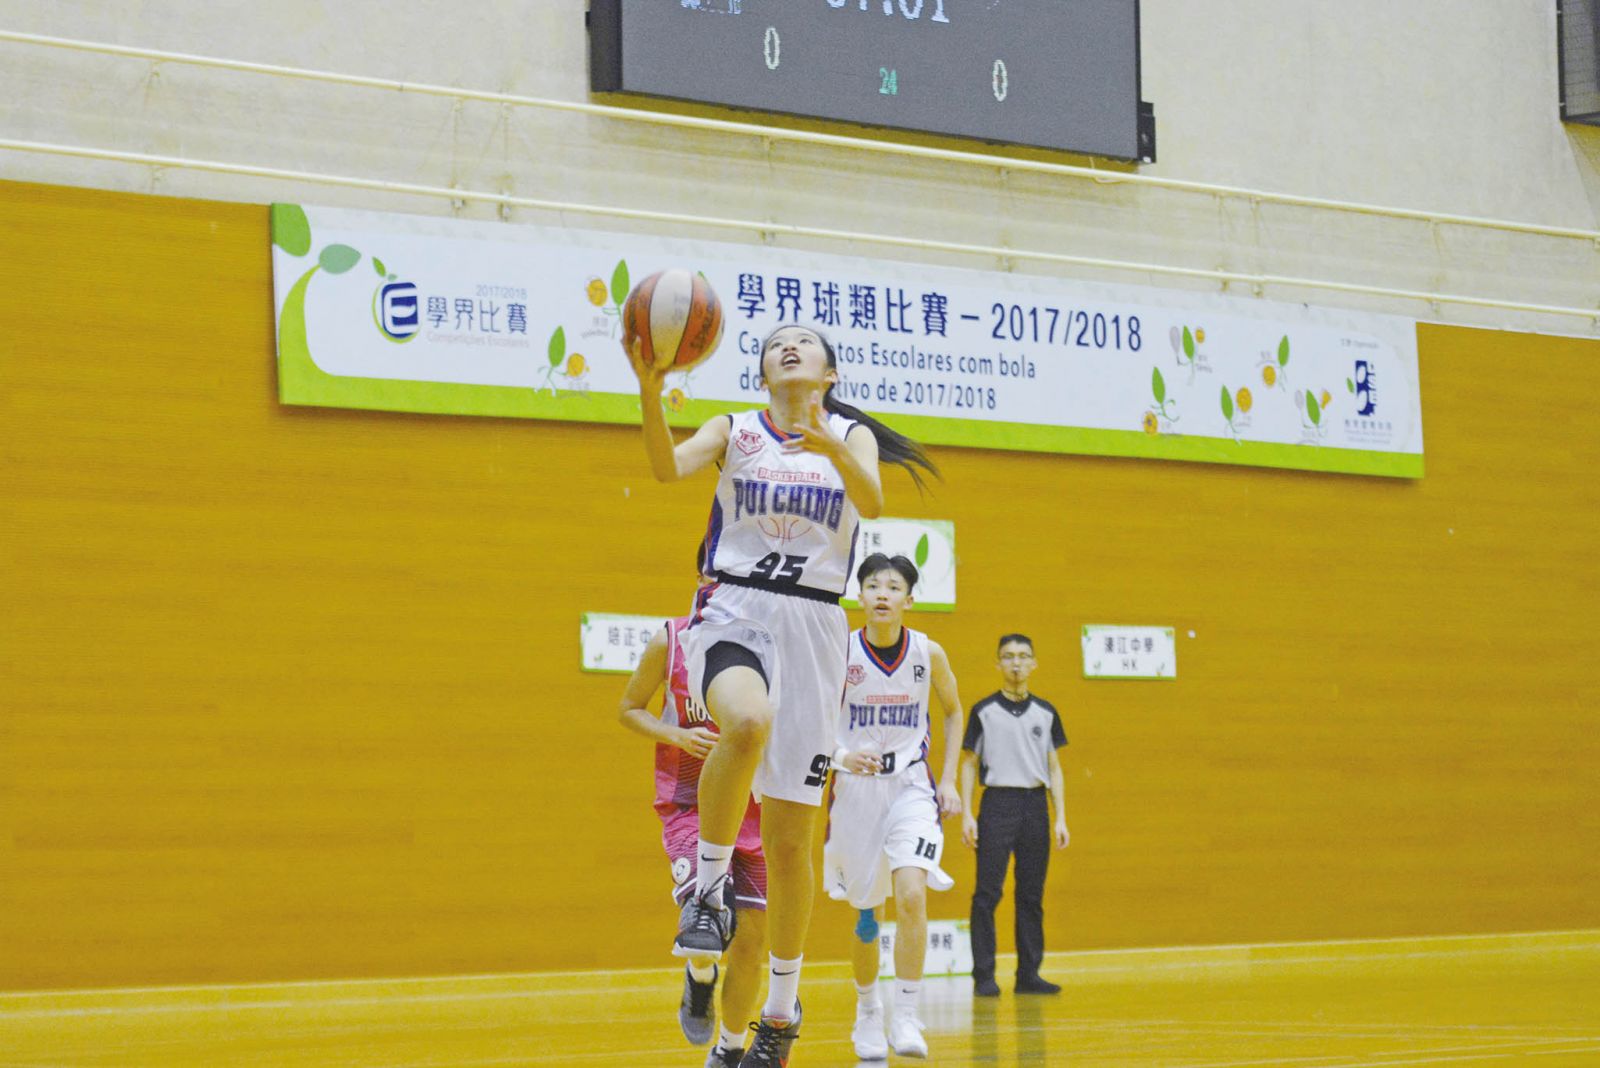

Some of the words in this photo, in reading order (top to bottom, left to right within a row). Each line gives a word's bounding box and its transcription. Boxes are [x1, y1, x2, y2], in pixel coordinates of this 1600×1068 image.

[764, 27, 780, 70] 0
[878, 67, 898, 96] 24
[992, 59, 1008, 102] 0
[427, 297, 527, 335] 學界比賽
[991, 303, 1142, 352] 2017/2018
[871, 343, 953, 372] Escolares
[958, 355, 993, 376] com
[999, 352, 1036, 379] bola
[877, 377, 897, 402] de
[904, 381, 996, 410] 2017/2018
[732, 478, 768, 522] PUI
[772, 483, 846, 533] CHING
[751, 551, 809, 583] 95
[608, 626, 652, 647] 培正中
[849, 702, 875, 731] PUI
[878, 701, 920, 729] CHING
